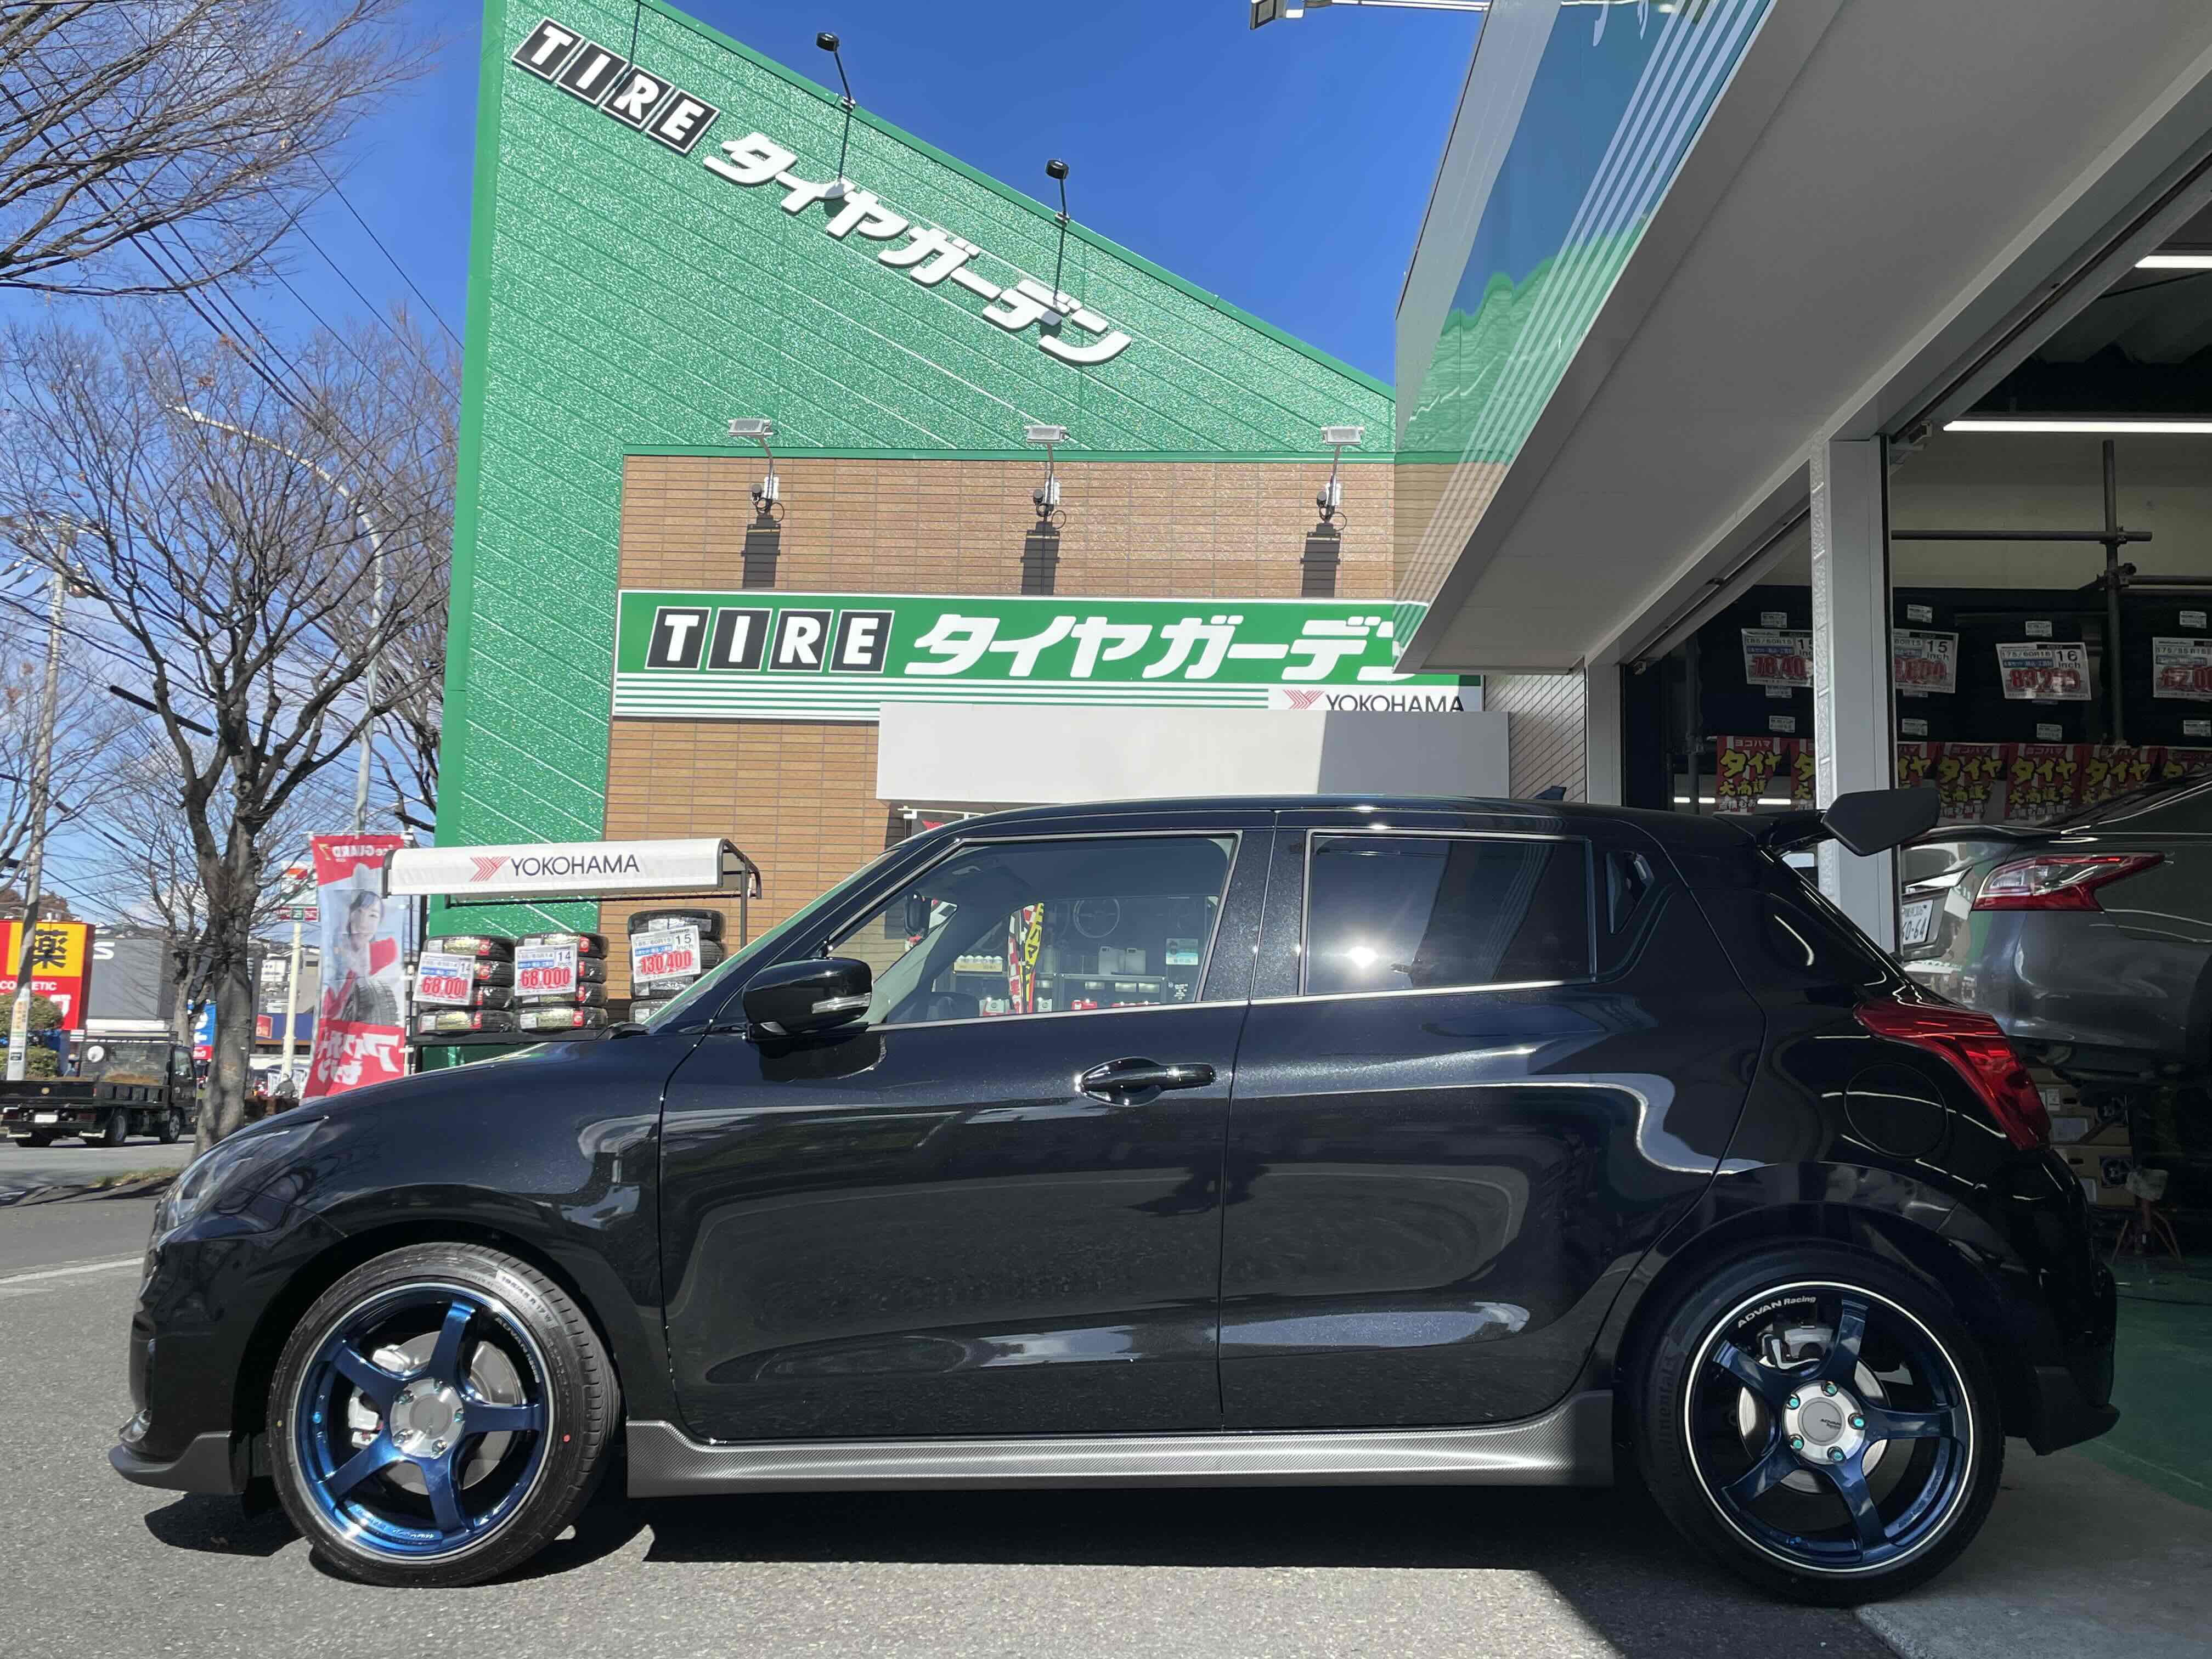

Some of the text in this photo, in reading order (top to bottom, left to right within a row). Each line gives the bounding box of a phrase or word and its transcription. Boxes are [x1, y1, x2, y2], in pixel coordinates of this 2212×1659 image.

[529, 25, 706, 141] TIRE
[702, 131, 1132, 364] タイヤガーデン
[664, 614, 879, 665] TIRE
[1927, 640, 1948, 653] 15
[2057, 651, 2078, 662] 16
[1327, 693, 1465, 712] YOKOHAMA
[2010, 757, 2078, 785] タイヤ
[511, 854, 640, 877] YOKOHAMA
[32, 929, 68, 969] 薬
[675, 934, 692, 944] 15
[0, 980, 57, 991] COETIC
[1737, 1295, 1817, 1329] ADVAN Racing
